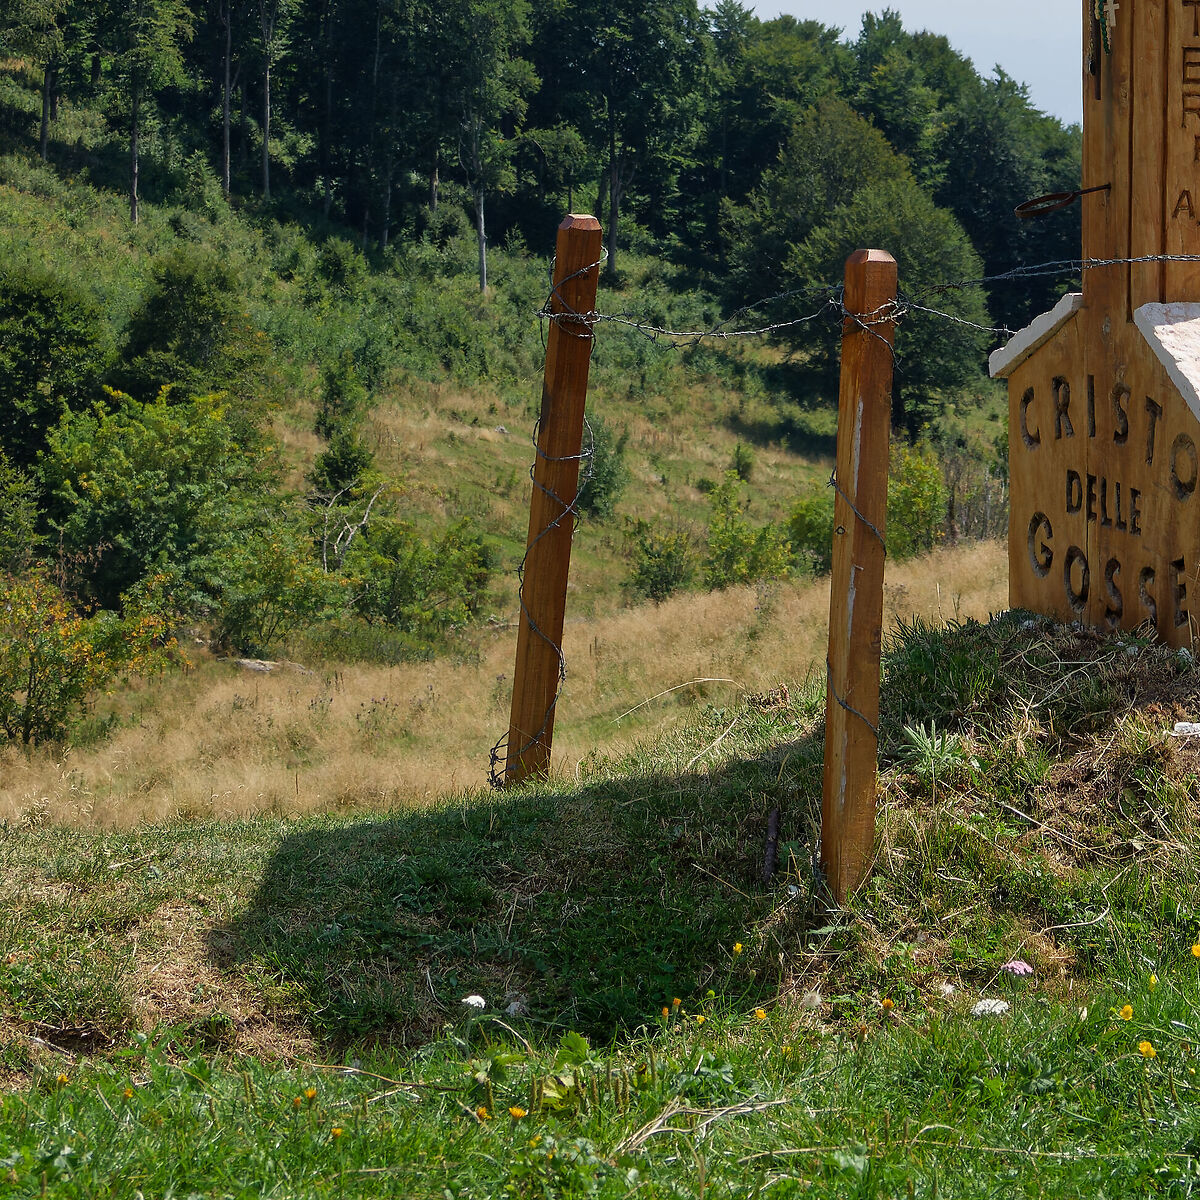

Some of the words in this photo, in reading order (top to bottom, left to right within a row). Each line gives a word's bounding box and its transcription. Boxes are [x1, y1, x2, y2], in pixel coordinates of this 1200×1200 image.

[1020, 375, 1198, 500] CRISTO
[1066, 469, 1142, 536] DELLE
[1027, 511, 1189, 632] GOSSE
